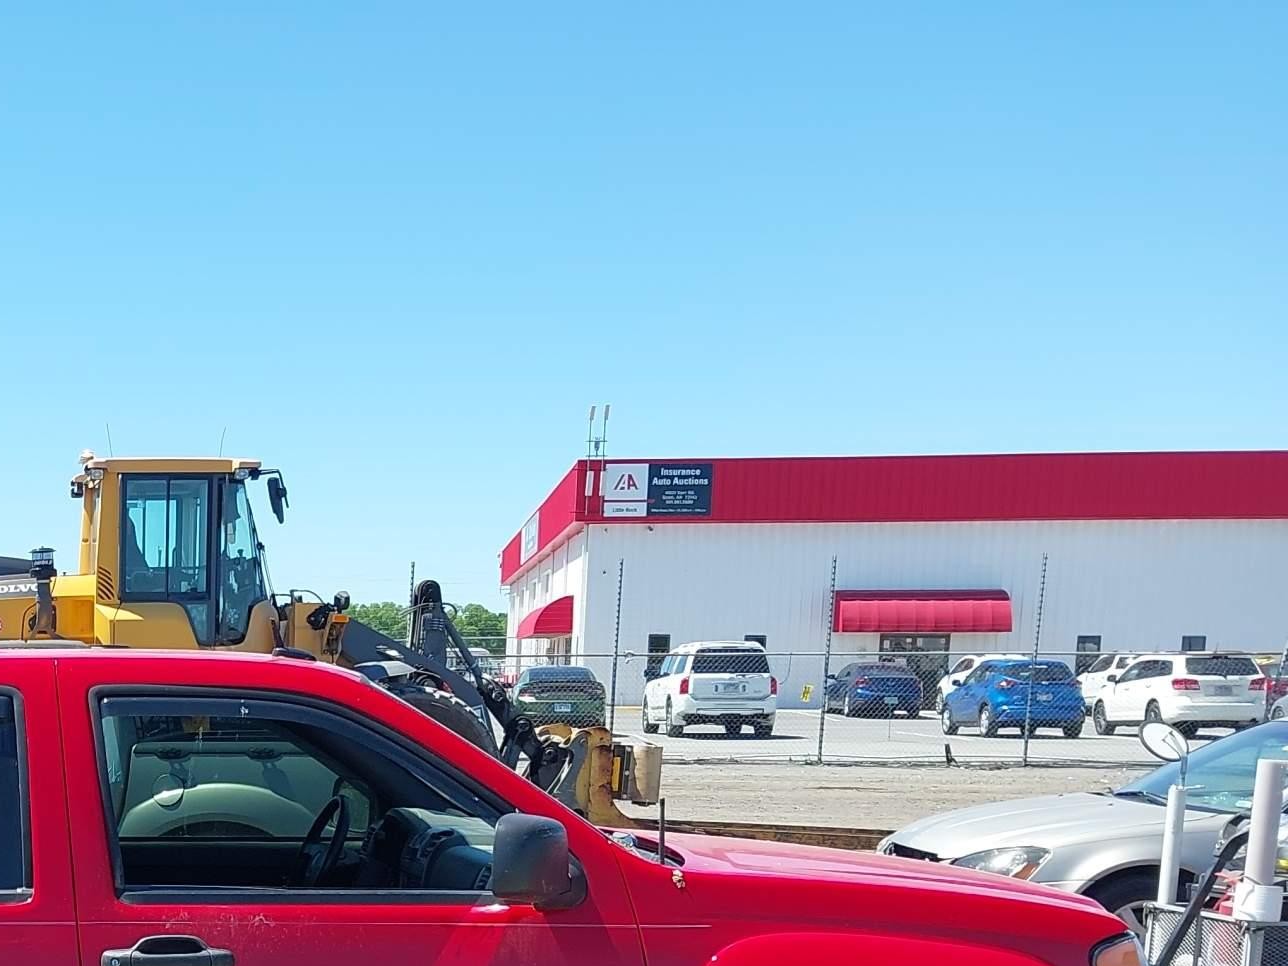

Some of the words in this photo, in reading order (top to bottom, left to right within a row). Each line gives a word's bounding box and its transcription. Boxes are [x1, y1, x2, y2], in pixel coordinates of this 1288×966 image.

[660, 468, 701, 476] Insurance
[652, 477, 671, 486] Auto
[673, 476, 708, 485] Auctions
